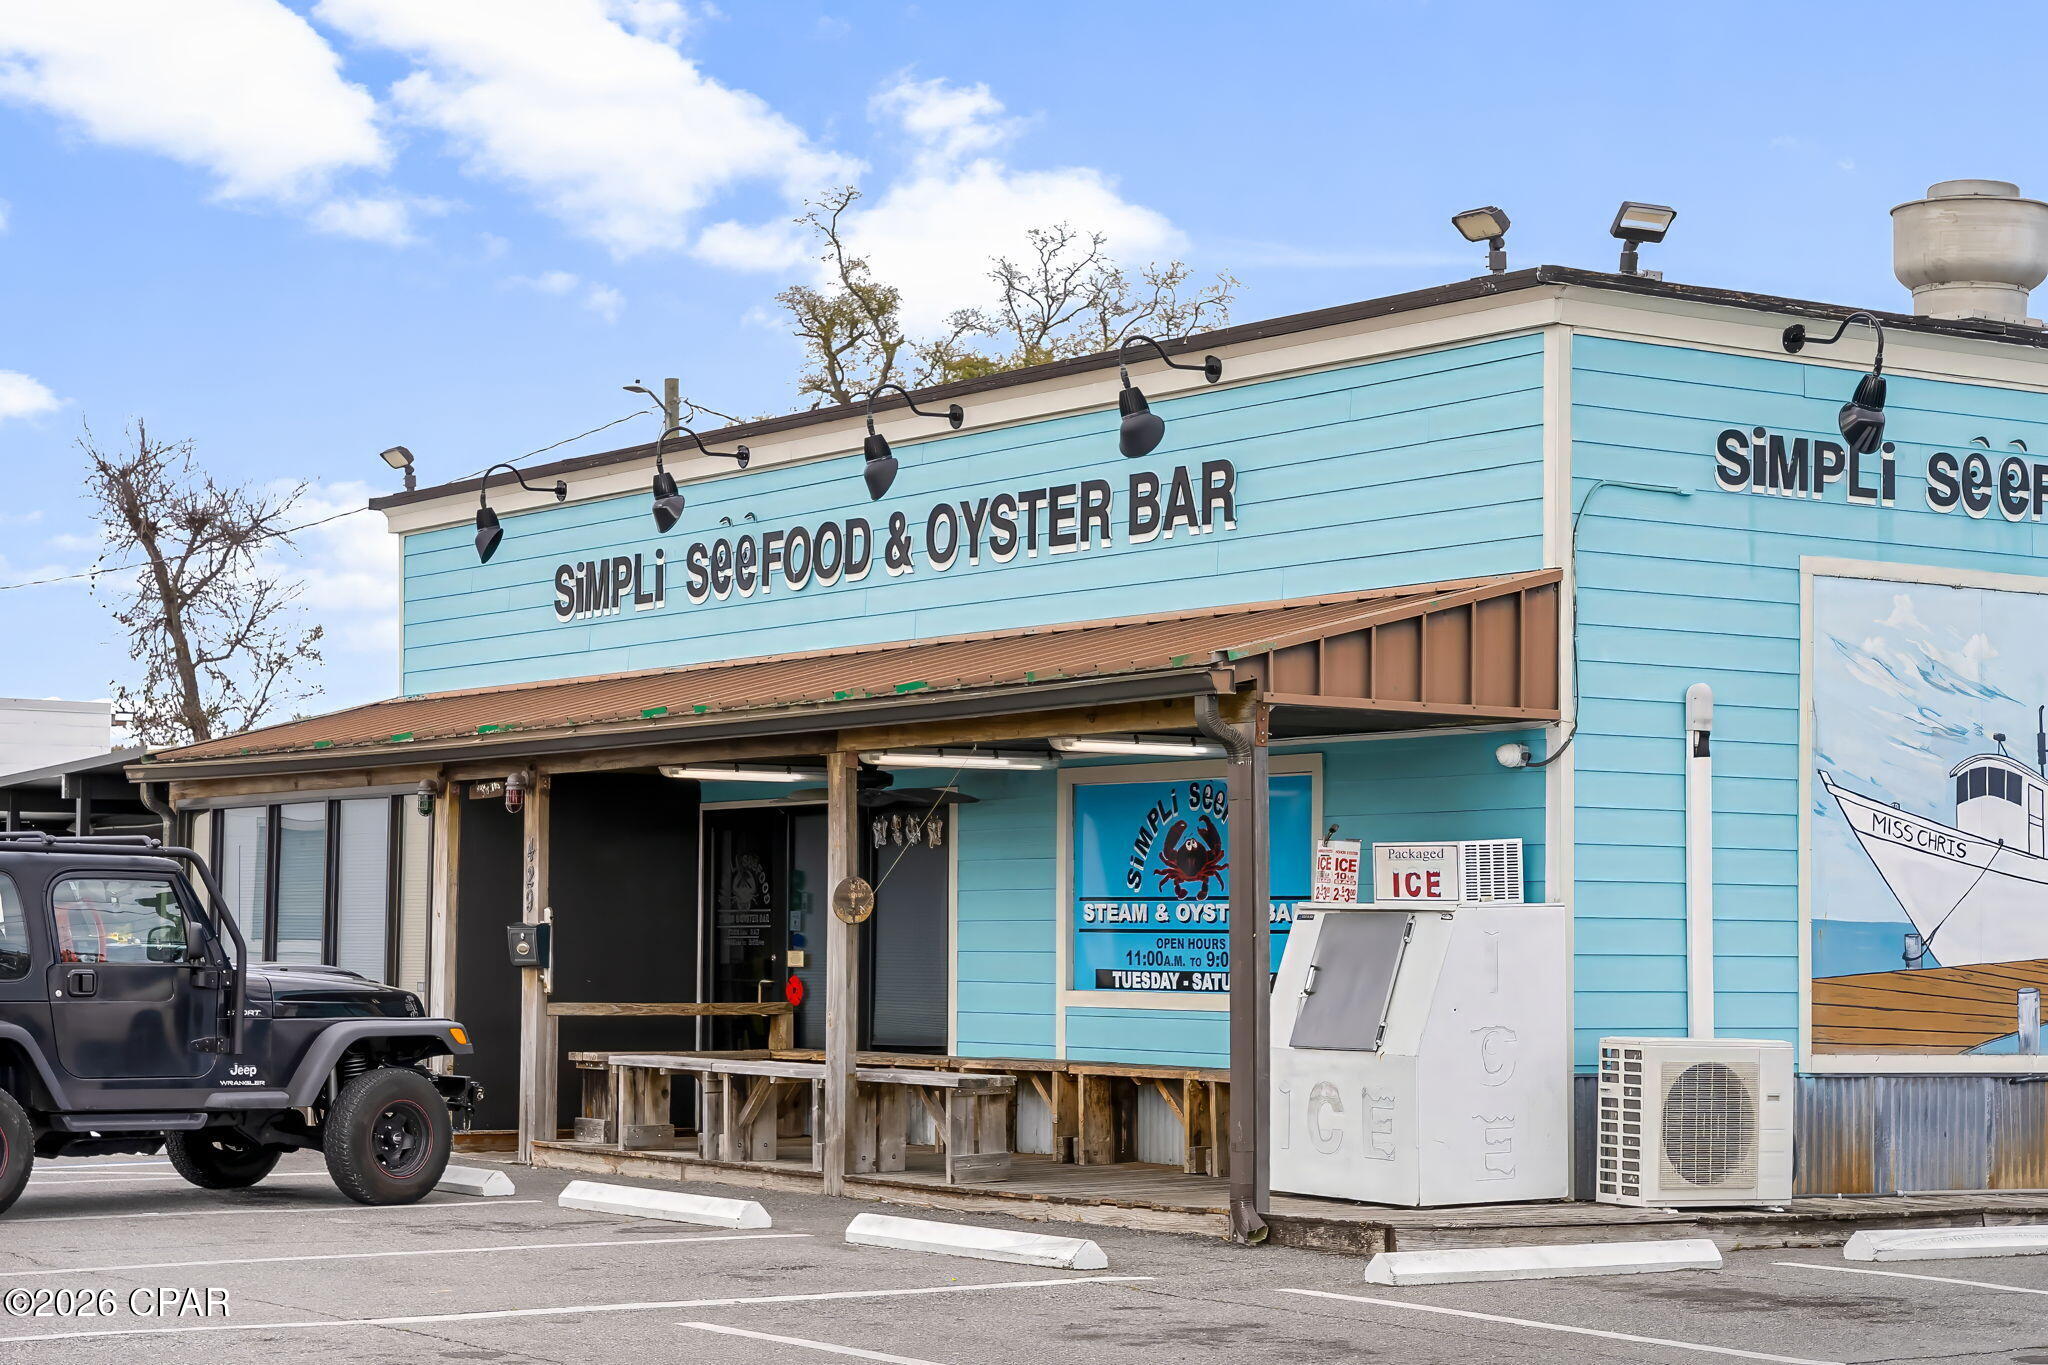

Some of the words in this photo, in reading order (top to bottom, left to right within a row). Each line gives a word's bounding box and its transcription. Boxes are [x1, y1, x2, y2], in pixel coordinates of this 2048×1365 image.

[885, 510, 914, 577] &
[926, 479, 1112, 572] OYSTER
[1129, 459, 1237, 544] BAR
[1872, 812, 1914, 842] MISS
[1917, 829, 1967, 858] CHRIS
[1388, 848, 1445, 861] Packaged
[1335, 858, 1357, 872] ICE
[1393, 869, 1441, 897] ICE
[1083, 903, 1148, 922] STEAM
[1155, 903, 1169, 921] &
[1176, 904, 1229, 923] OYST
[1156, 937, 1184, 950] OPEN
[1188, 937, 1226, 950] HOURS
[1206, 951, 1229, 967] 9:0
[1112, 971, 1180, 990] TUESDAY
[229, 1063, 257, 1077] Jeep
